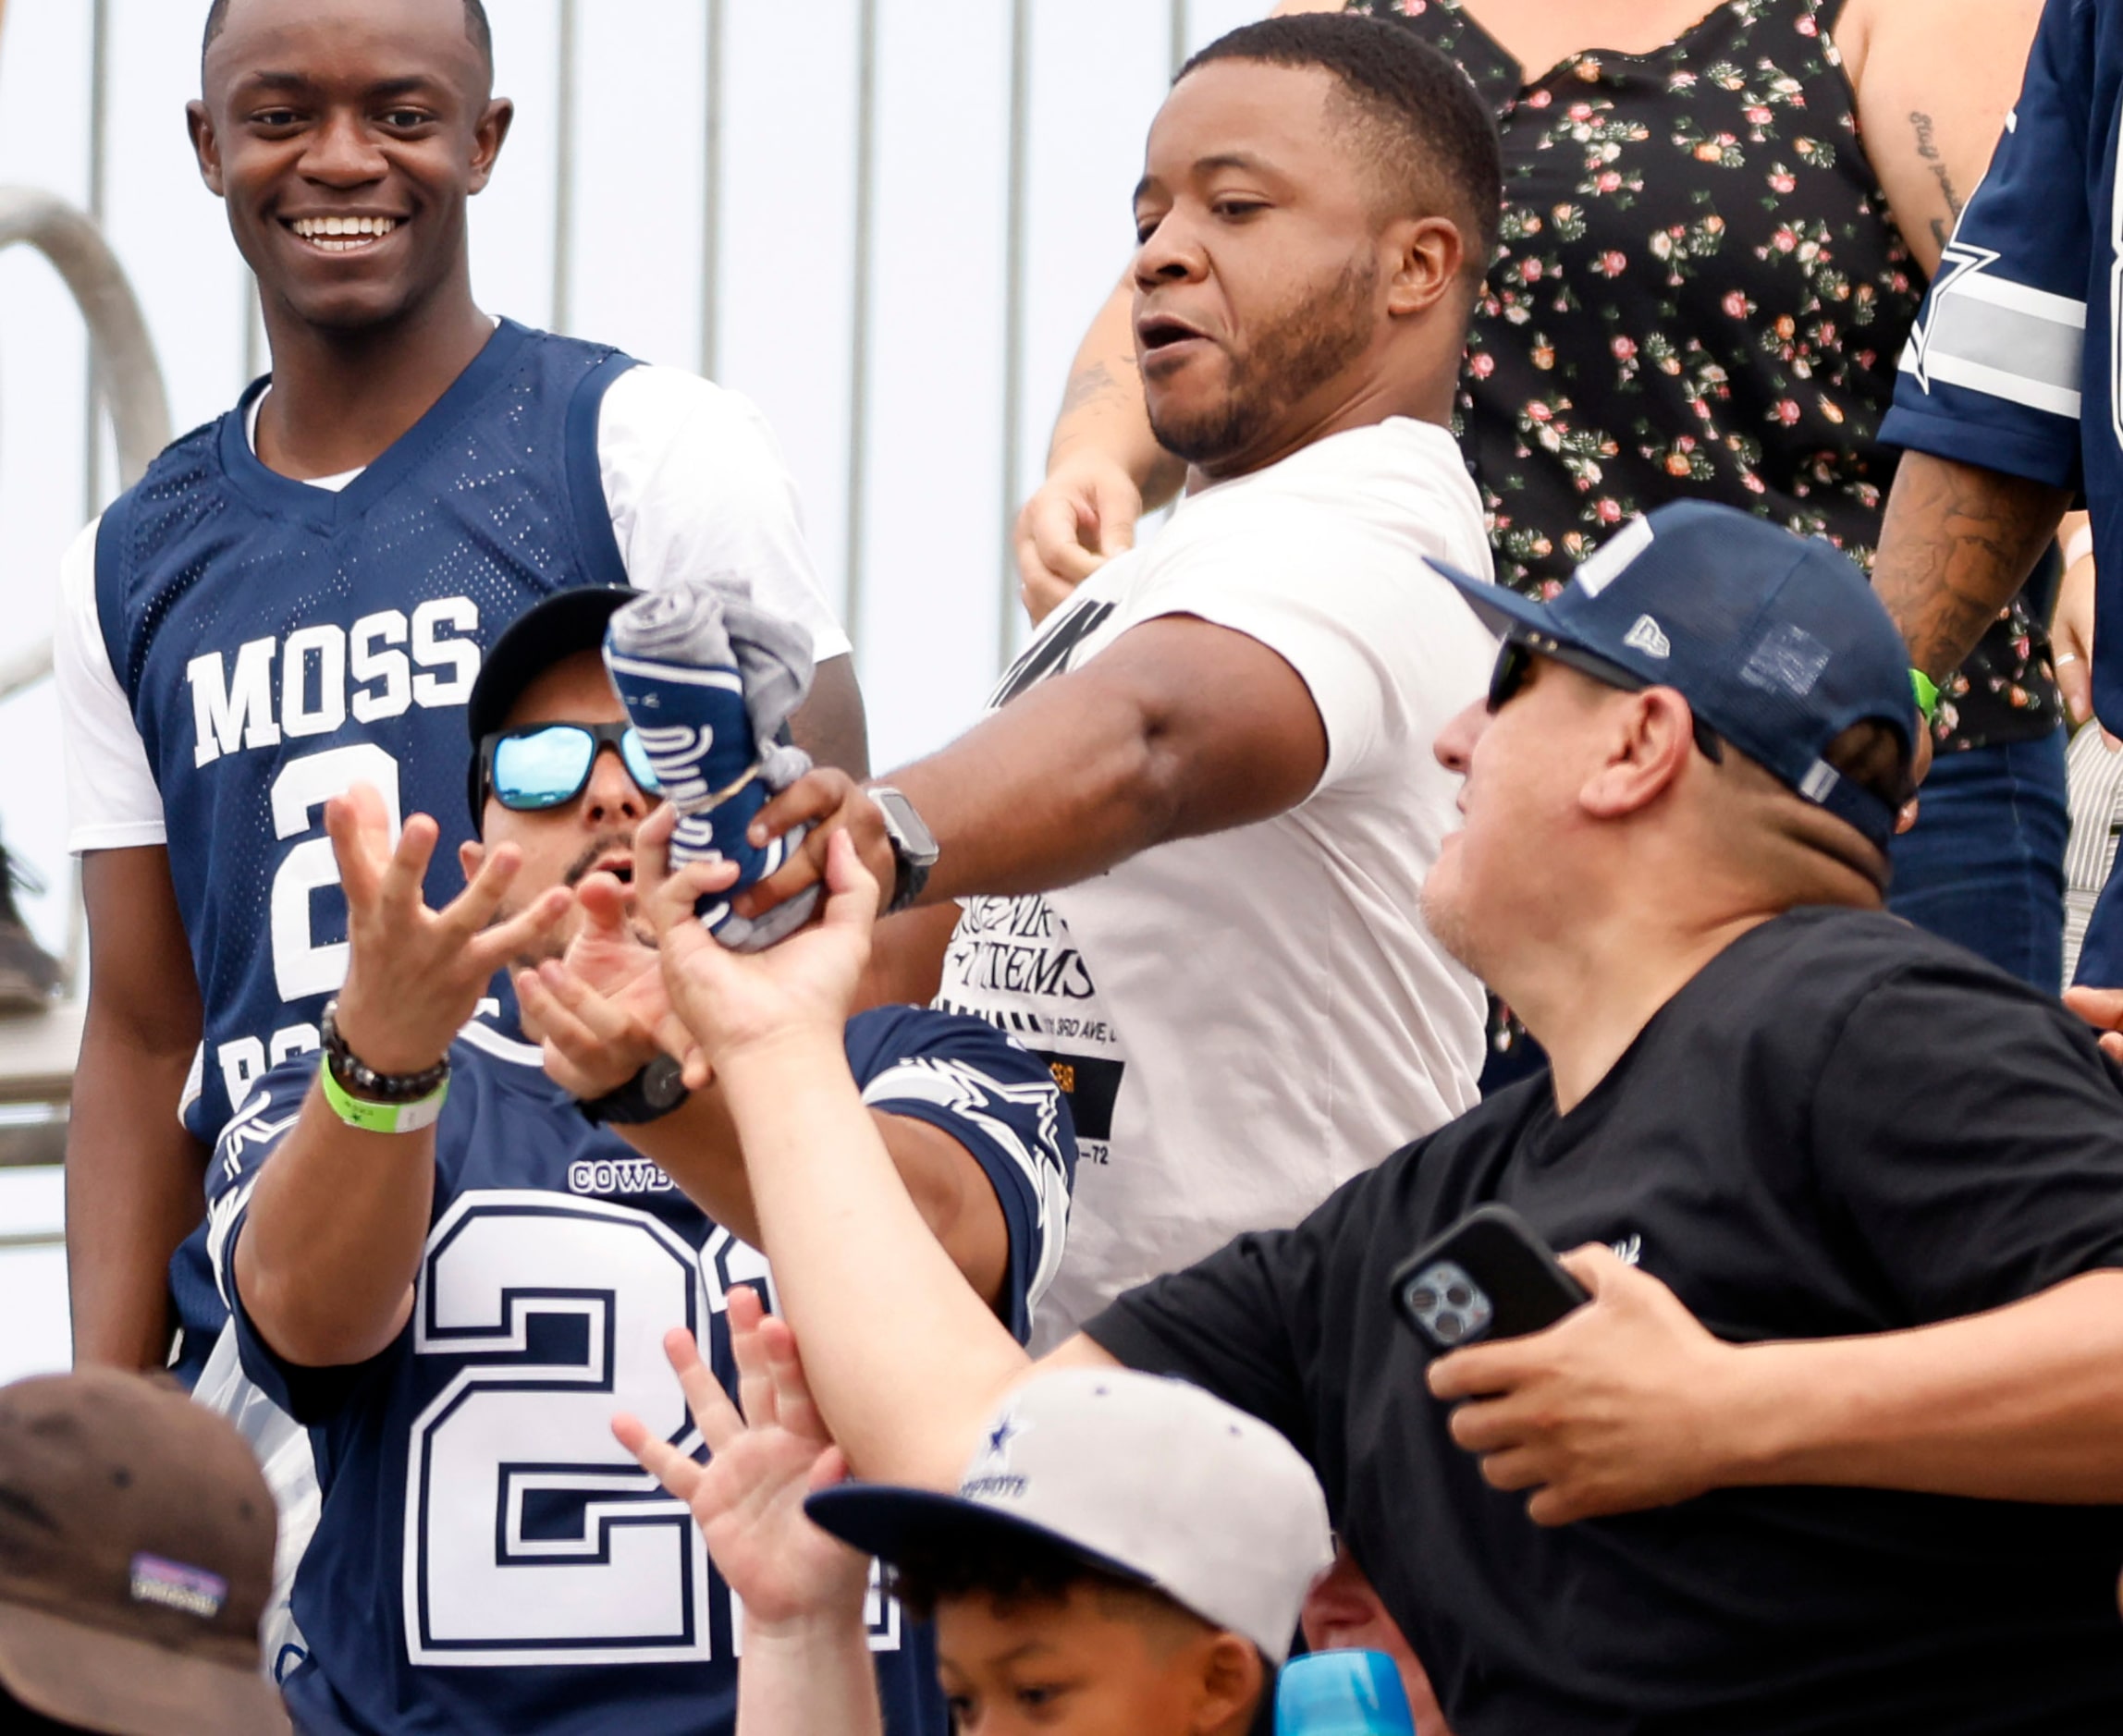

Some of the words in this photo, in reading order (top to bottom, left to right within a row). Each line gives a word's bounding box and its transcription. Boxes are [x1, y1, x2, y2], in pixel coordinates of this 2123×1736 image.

[187, 595, 482, 769] MOSS
[270, 743, 402, 1003] 2
[568, 1157, 681, 1194] COWB
[402, 1189, 901, 1667] 2
